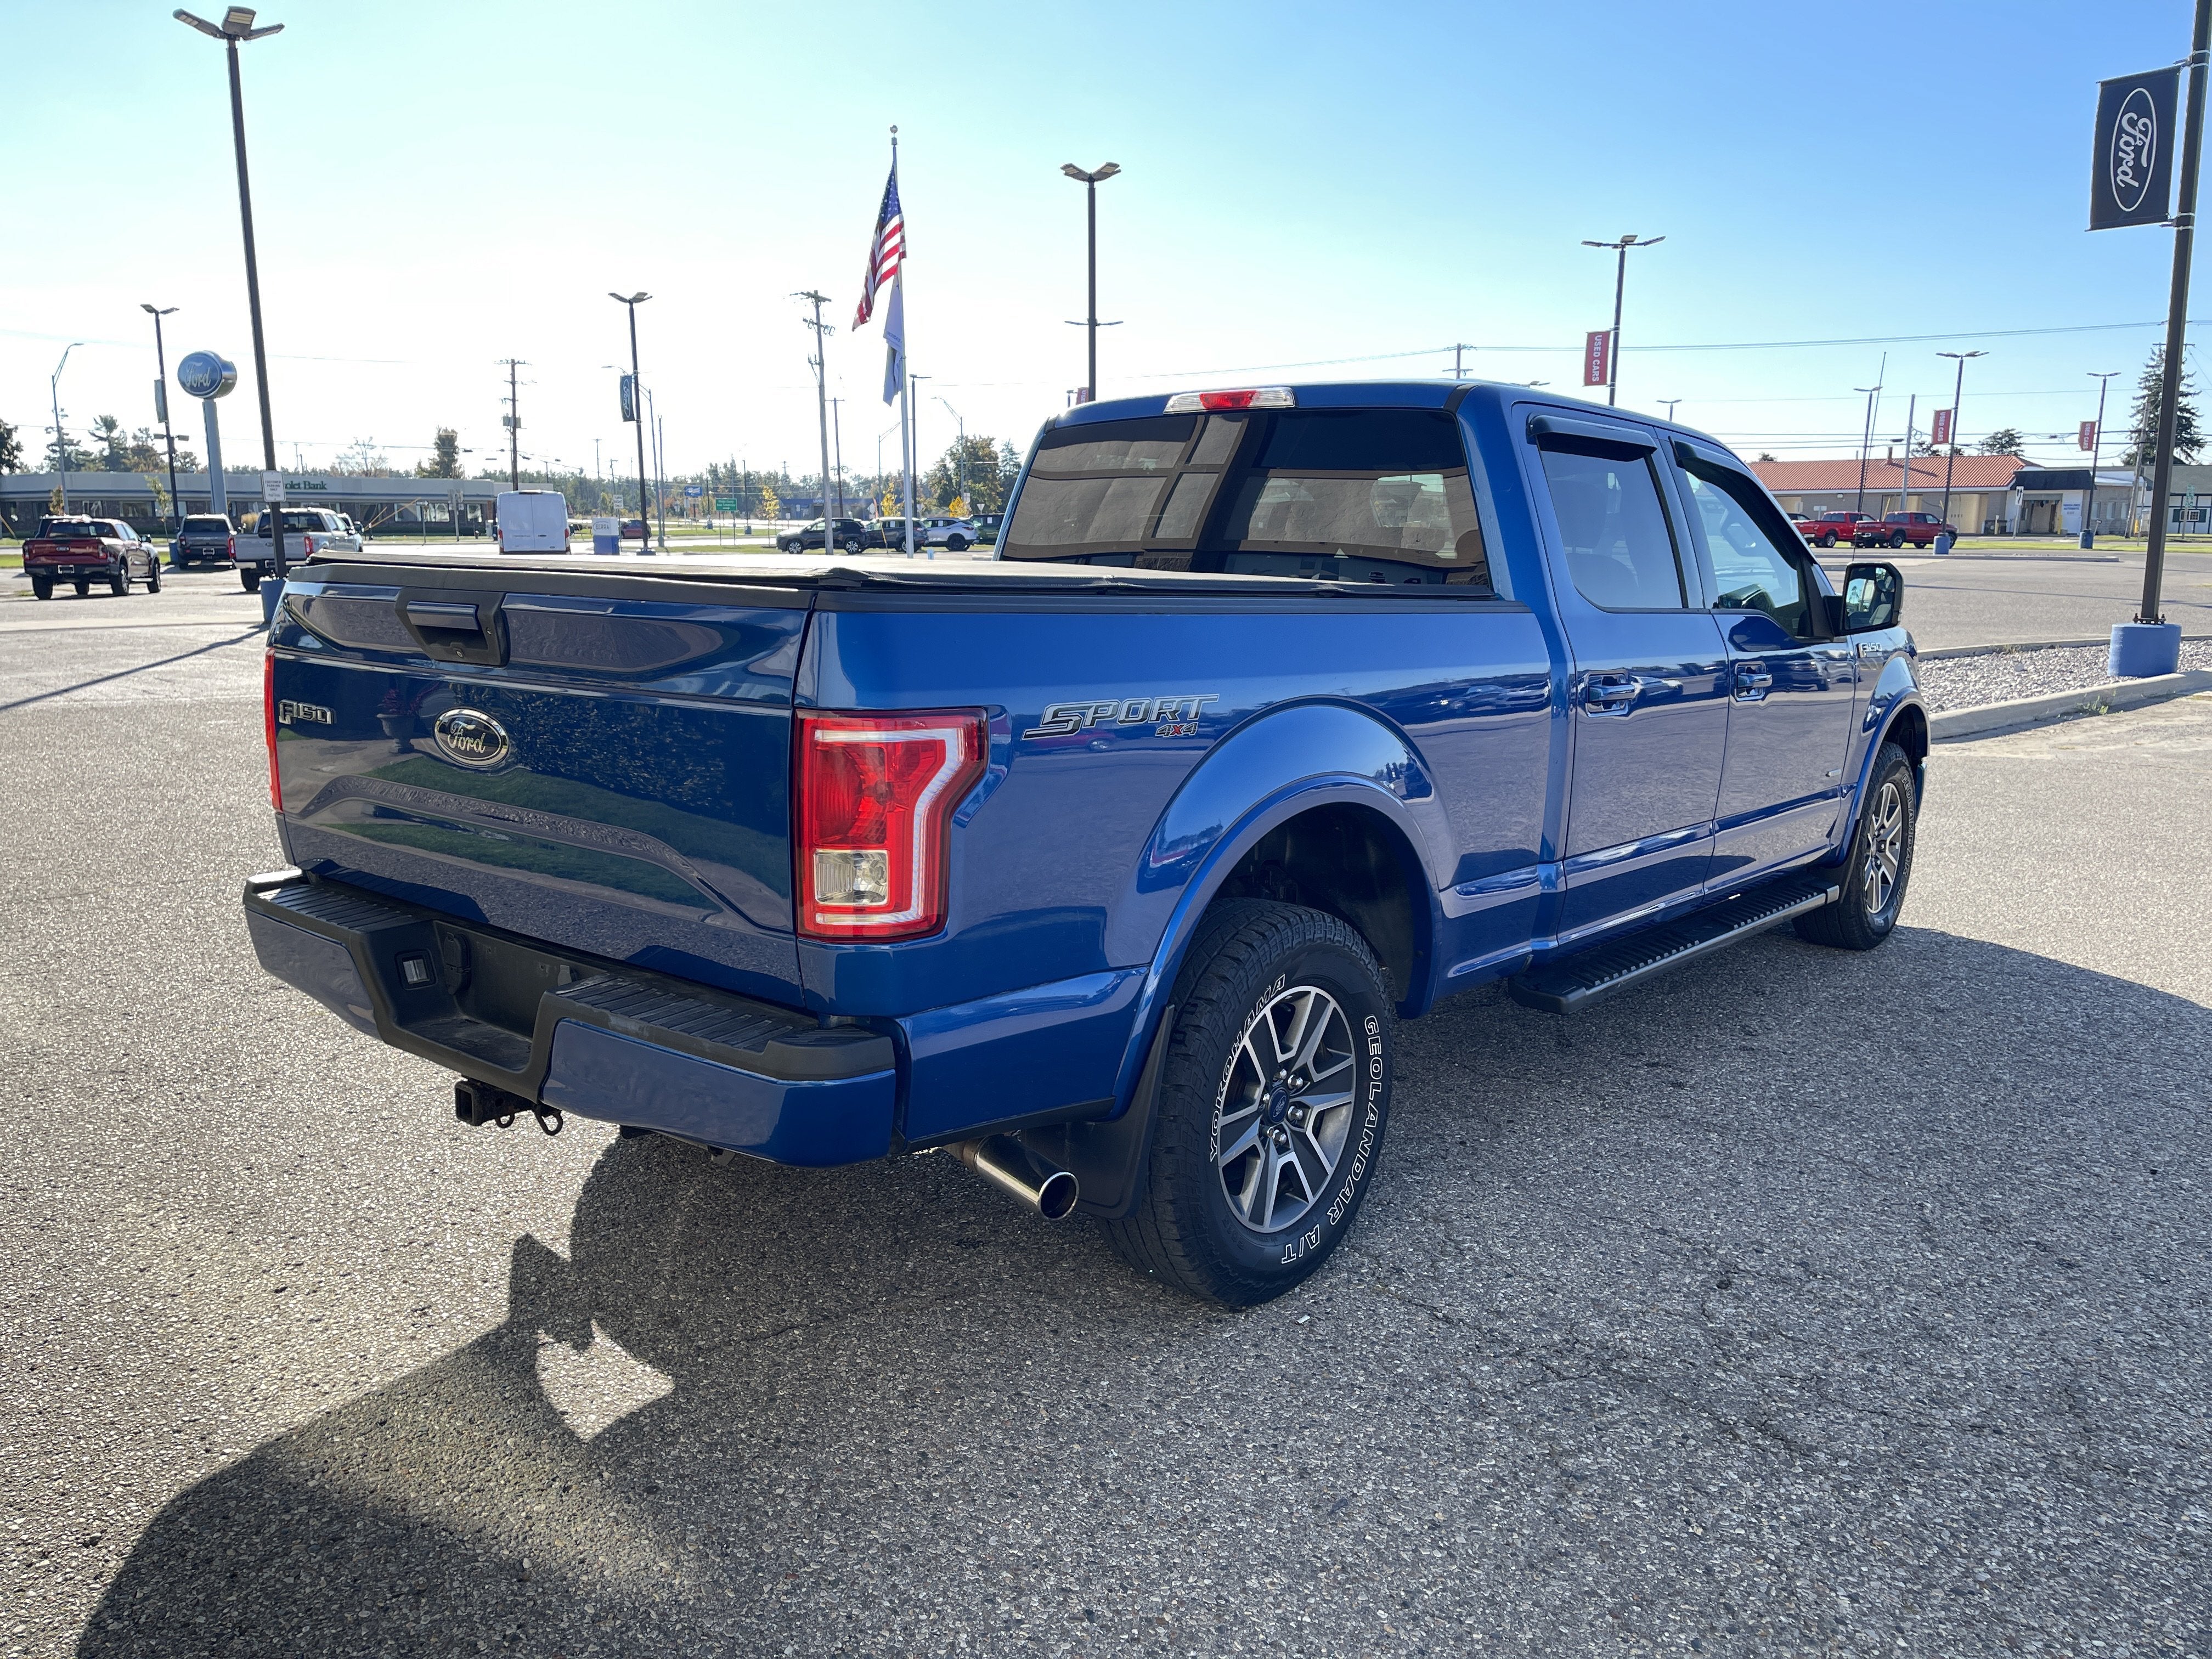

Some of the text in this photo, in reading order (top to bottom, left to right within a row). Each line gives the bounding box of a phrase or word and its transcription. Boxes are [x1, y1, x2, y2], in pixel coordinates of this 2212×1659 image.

[2116, 111, 2152, 188] Ford
[184, 361, 212, 388] Ford
[1592, 335, 1602, 382] USED CARS
[303, 481, 328, 490] Bank
[447, 720, 487, 754] Ford
[1022, 693, 1220, 741] SPORT
[1901, 773, 1915, 878] GEOLANDAR
[1209, 974, 1285, 1163] YOKOHAMA
[1282, 1014, 1384, 1264] GEOLANDAR A/T
